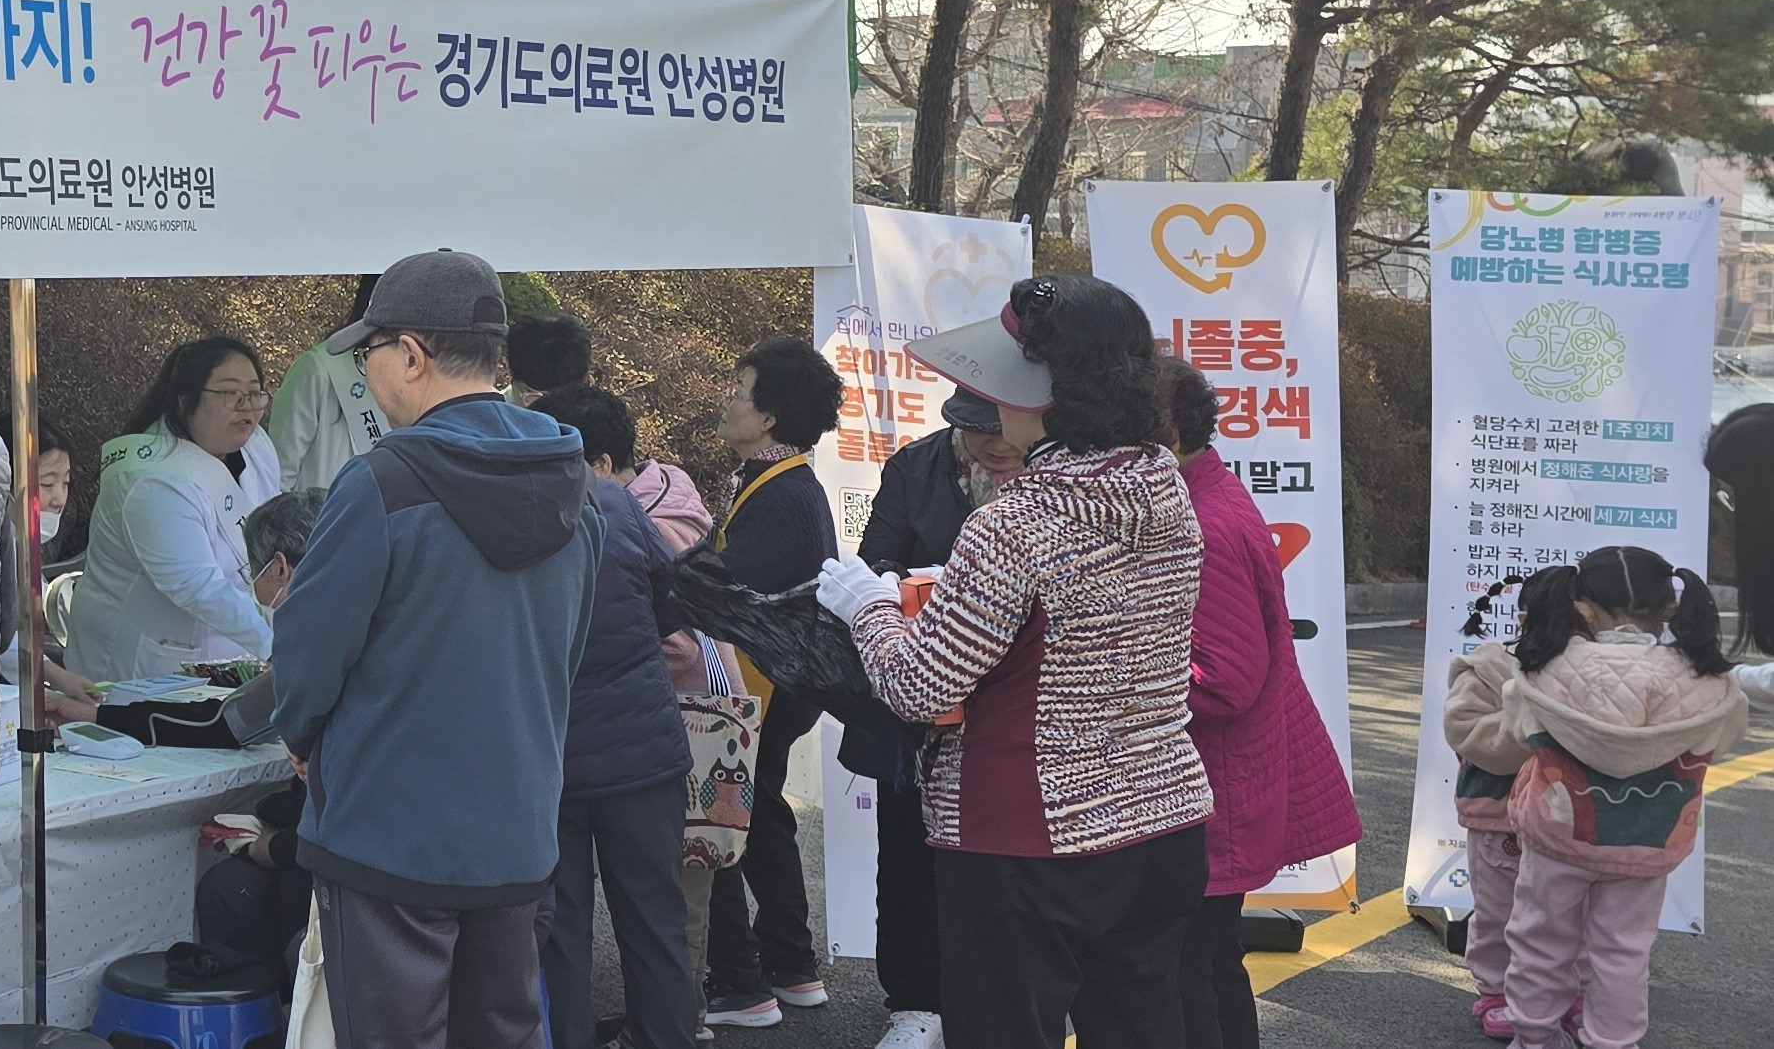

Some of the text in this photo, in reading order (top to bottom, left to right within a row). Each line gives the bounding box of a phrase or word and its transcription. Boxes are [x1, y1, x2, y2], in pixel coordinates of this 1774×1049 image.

[131, 6, 242, 99] 건강
[434, 32, 655, 116] 경기도의료원
[658, 52, 786, 124] 안성병원
[121, 164, 216, 210] 안성병원
[0, 215, 65, 231] PROVINCIAL
[67, 216, 113, 231] MEDICAL
[125, 220, 158, 232] ANSUNG
[159, 220, 197, 232] HOSPITAL
[1480, 225, 1662, 255] 당뇨병 합병증
[1451, 256, 1690, 289] 예방하는 식사요령
[837, 317, 882, 338] 집에서
[836, 345, 938, 382] 찾아가는
[840, 386, 925, 424] 경기도
[1473, 415, 1668, 439] 혈당수치 고려한 1주일치
[1471, 434, 1578, 454] 식단표를 짜라
[1249, 460, 1314, 494] 말고
[1471, 458, 1669, 483] 병원에서 정해준 식사량을
[1469, 477, 1520, 494] 지켜라
[1469, 501, 1673, 527] 늘 정해진 시간에 세 끼 식사
[1490, 521, 1524, 537] 하라
[1468, 544, 1501, 560] 밥과
[1506, 547, 1527, 562] 국,
[1535, 548, 1566, 564] 김치
[1467, 563, 1499, 579] 하지
